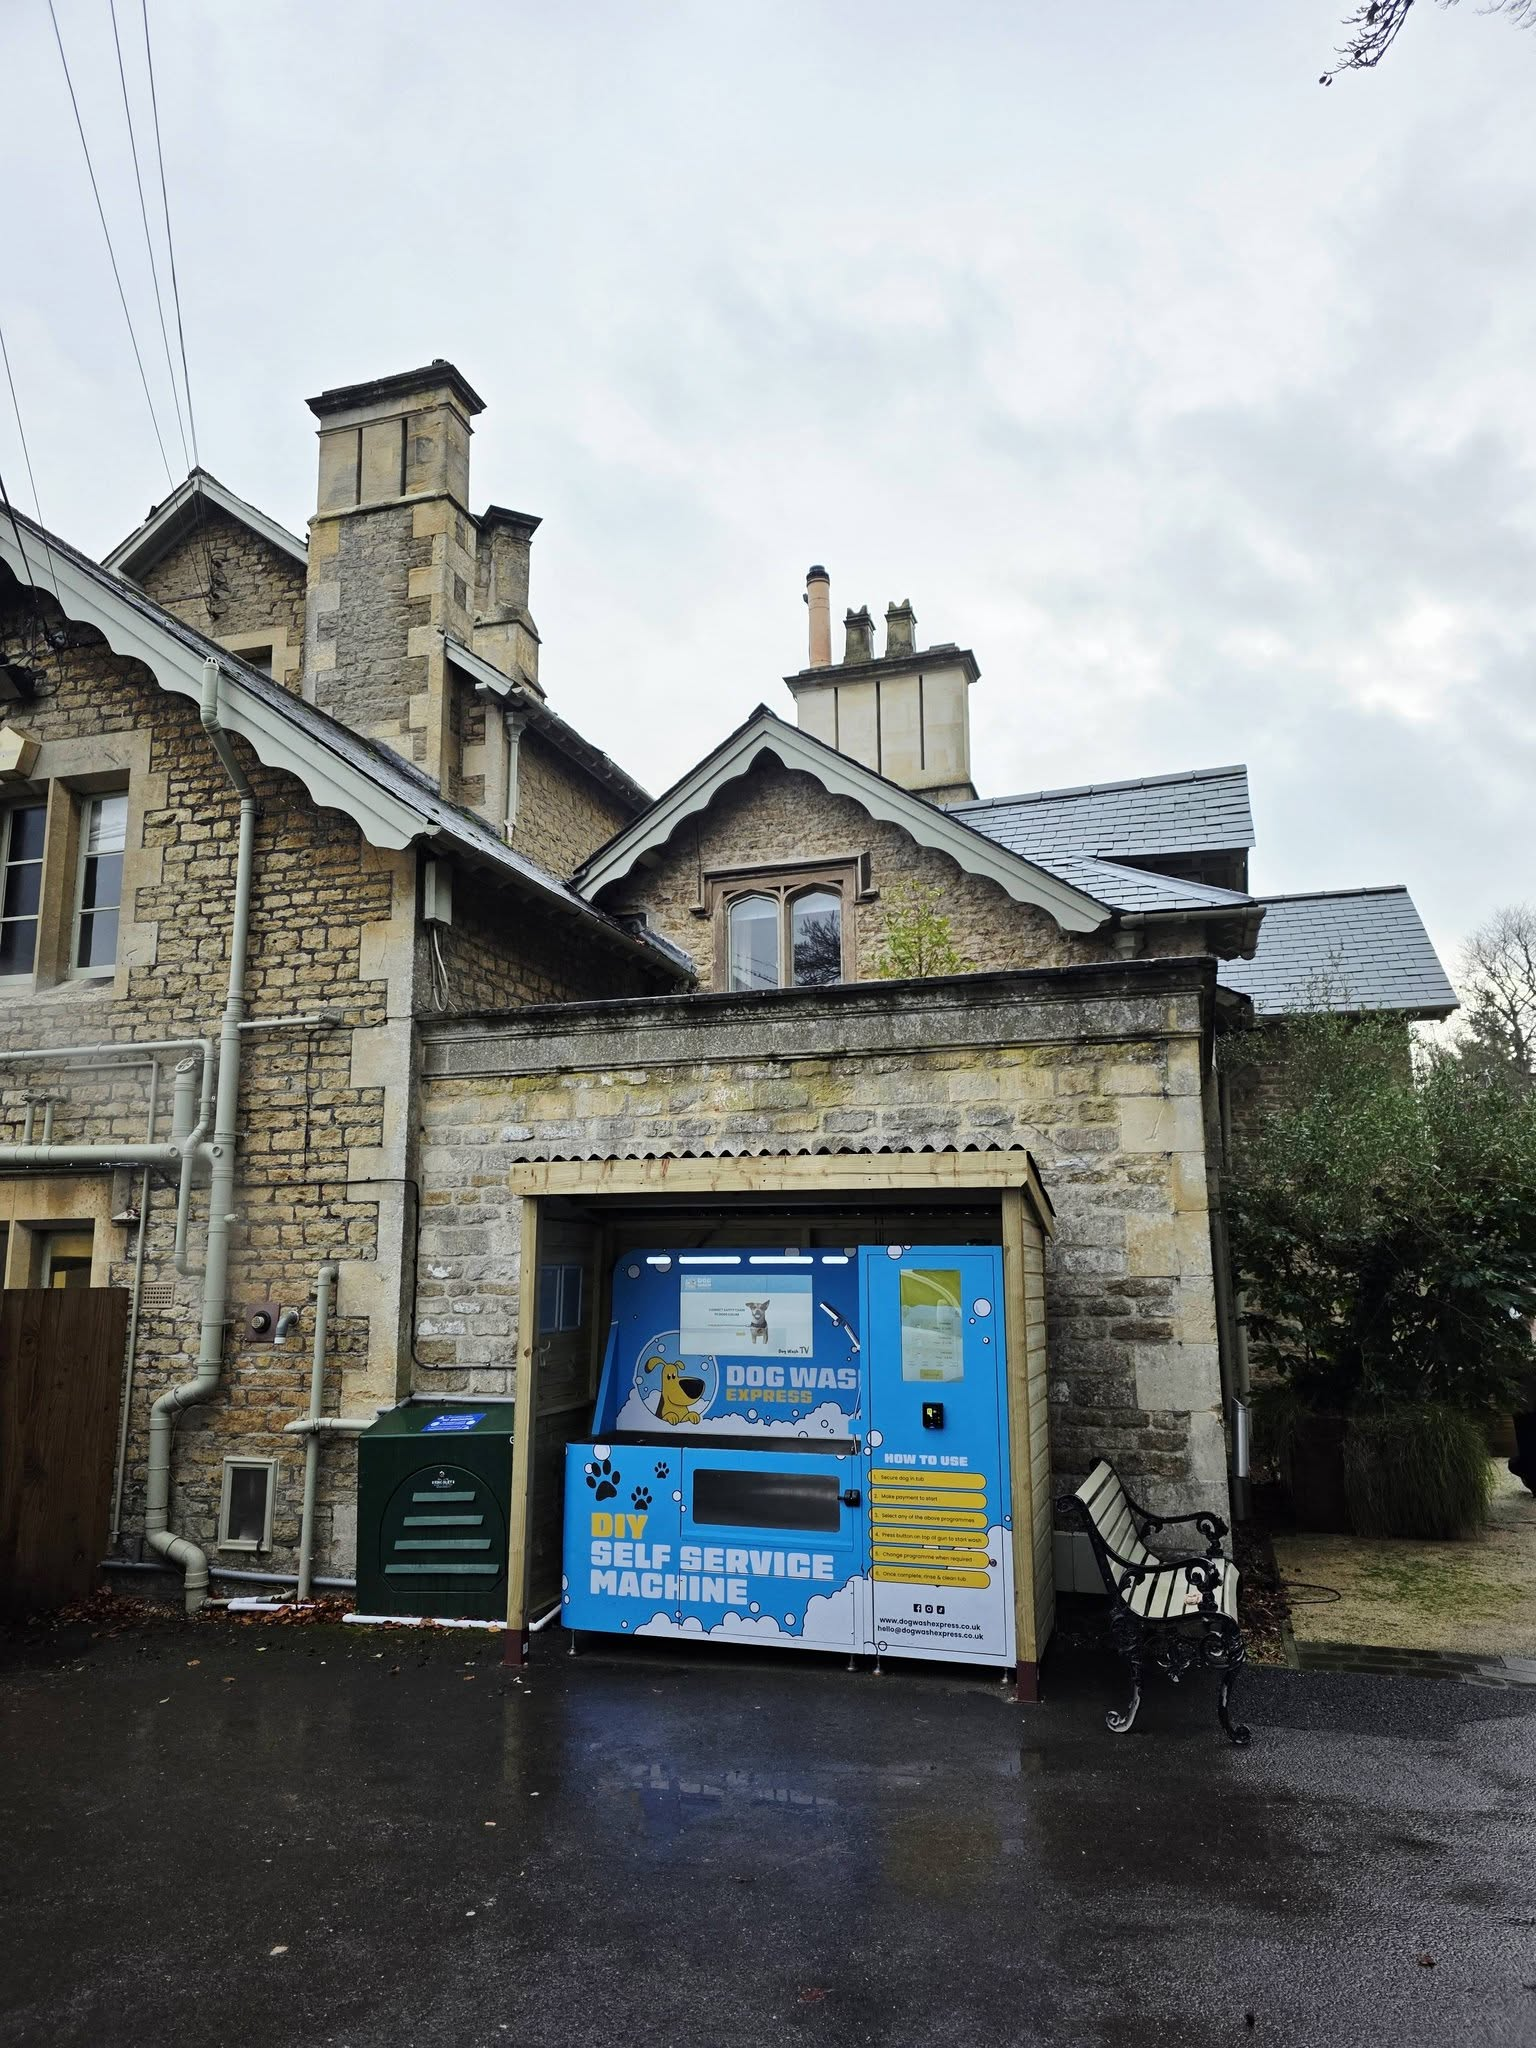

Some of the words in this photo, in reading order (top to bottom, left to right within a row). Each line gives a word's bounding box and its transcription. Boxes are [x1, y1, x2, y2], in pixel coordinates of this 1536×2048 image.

[800, 1346, 810, 1354] TV
[726, 1365, 785, 1387] DOG
[789, 1366, 861, 1389] WAS
[726, 1388, 812, 1404] EXPRESS
[884, 1453, 916, 1464] HOW
[919, 1454, 937, 1465] TO
[940, 1455, 968, 1467] USE
[591, 1512, 648, 1540] DIY
[590, 1540, 671, 1570] SELF
[680, 1546, 834, 1580] SERVICE
[904, 1553, 935, 1561] programme
[950, 1555, 972, 1563] required
[590, 1569, 748, 1606] MACHINE
[880, 1617, 981, 1631] www.dogwashexpress.co.uk
[877, 1625, 984, 1640] hello@dogwashexpress.co.uk
